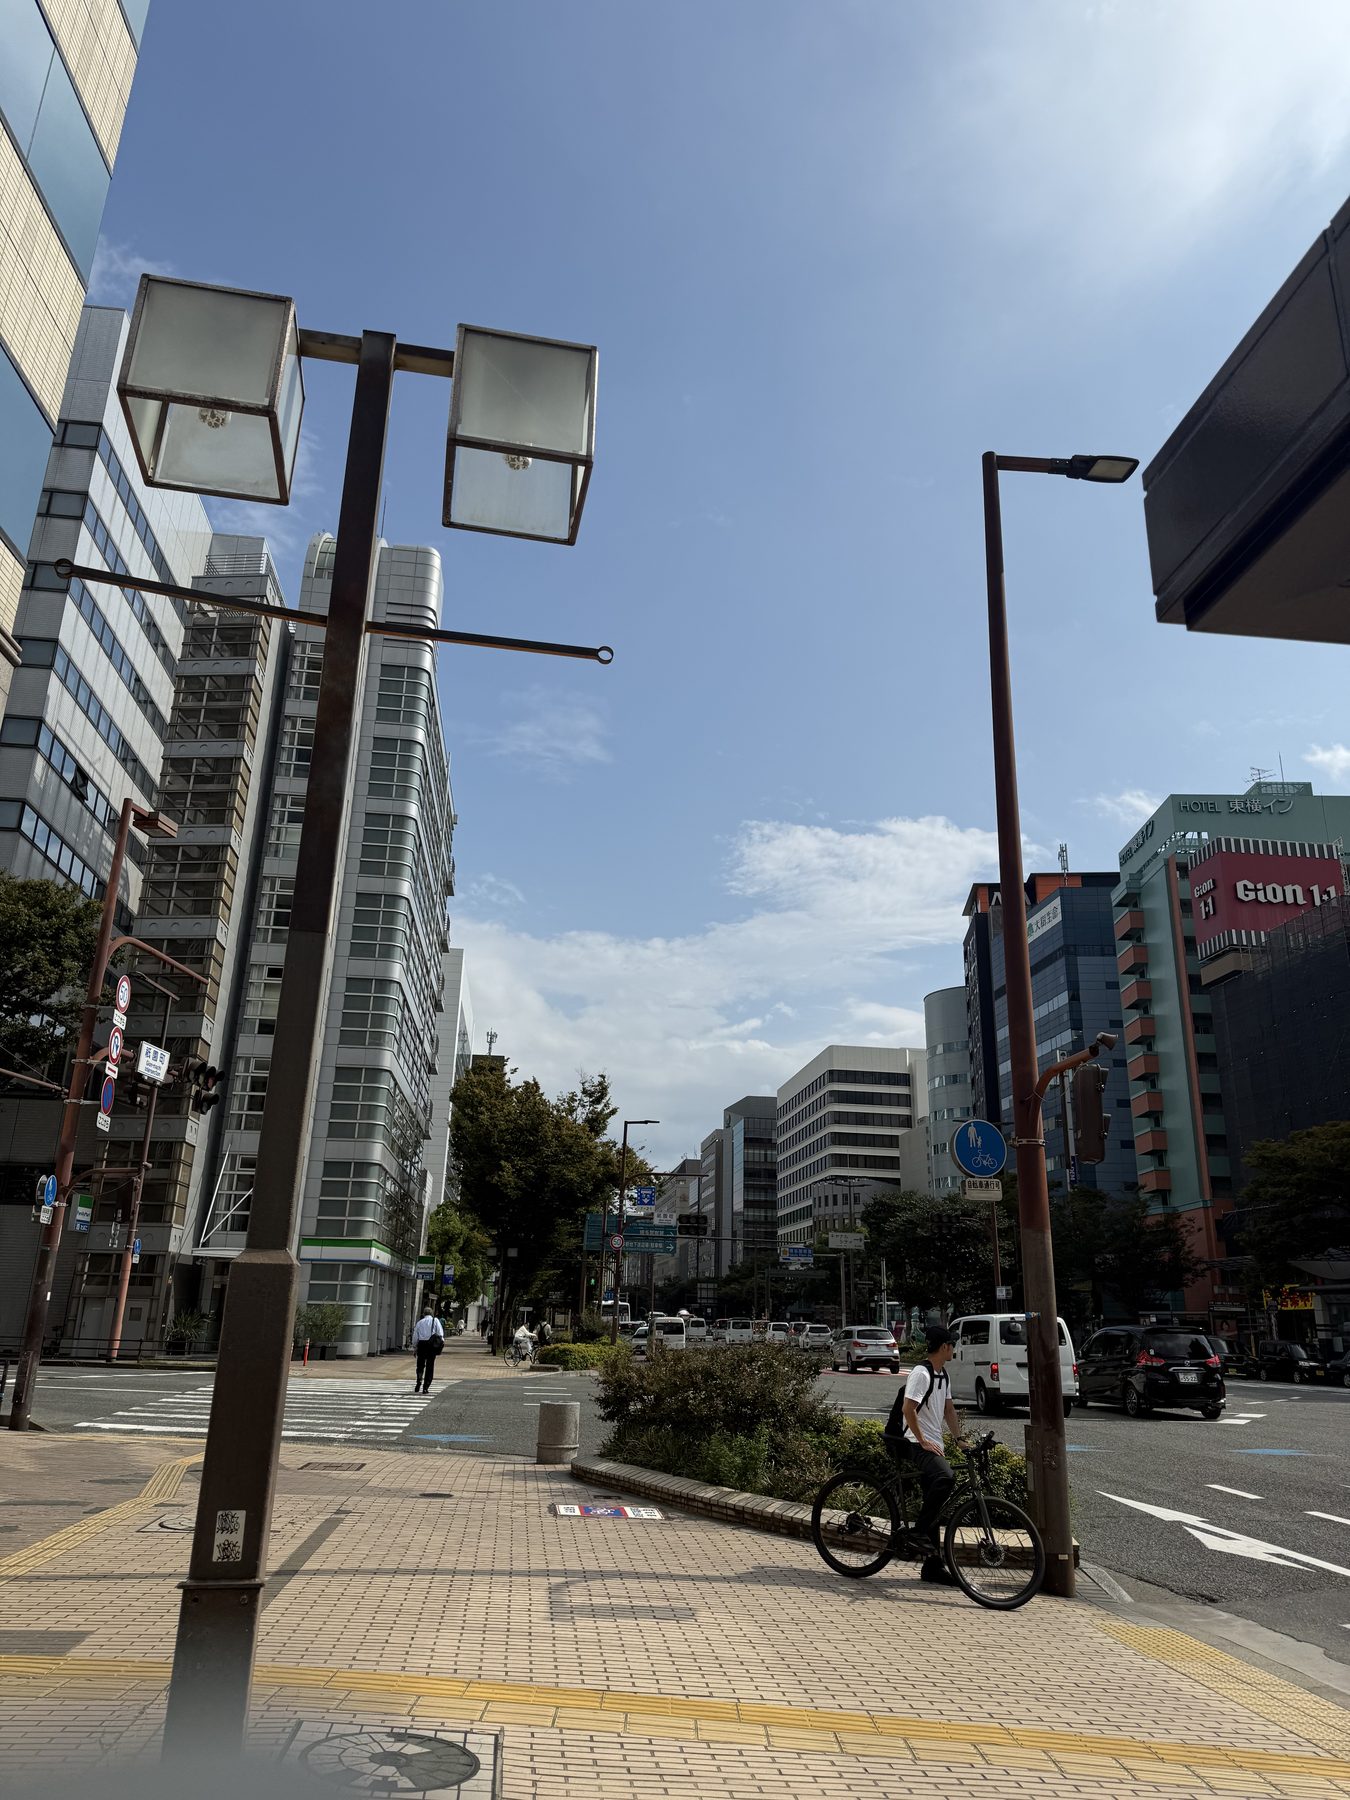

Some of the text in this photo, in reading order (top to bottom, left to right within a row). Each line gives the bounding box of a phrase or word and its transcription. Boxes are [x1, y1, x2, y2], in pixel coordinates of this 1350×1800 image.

[1180, 798, 1294, 814] HOTEL 東横イン
[1194, 878, 1214, 898] Gion
[1236, 879, 1307, 905] Gion
[967, 1180, 1000, 1190] 自転車通行可
